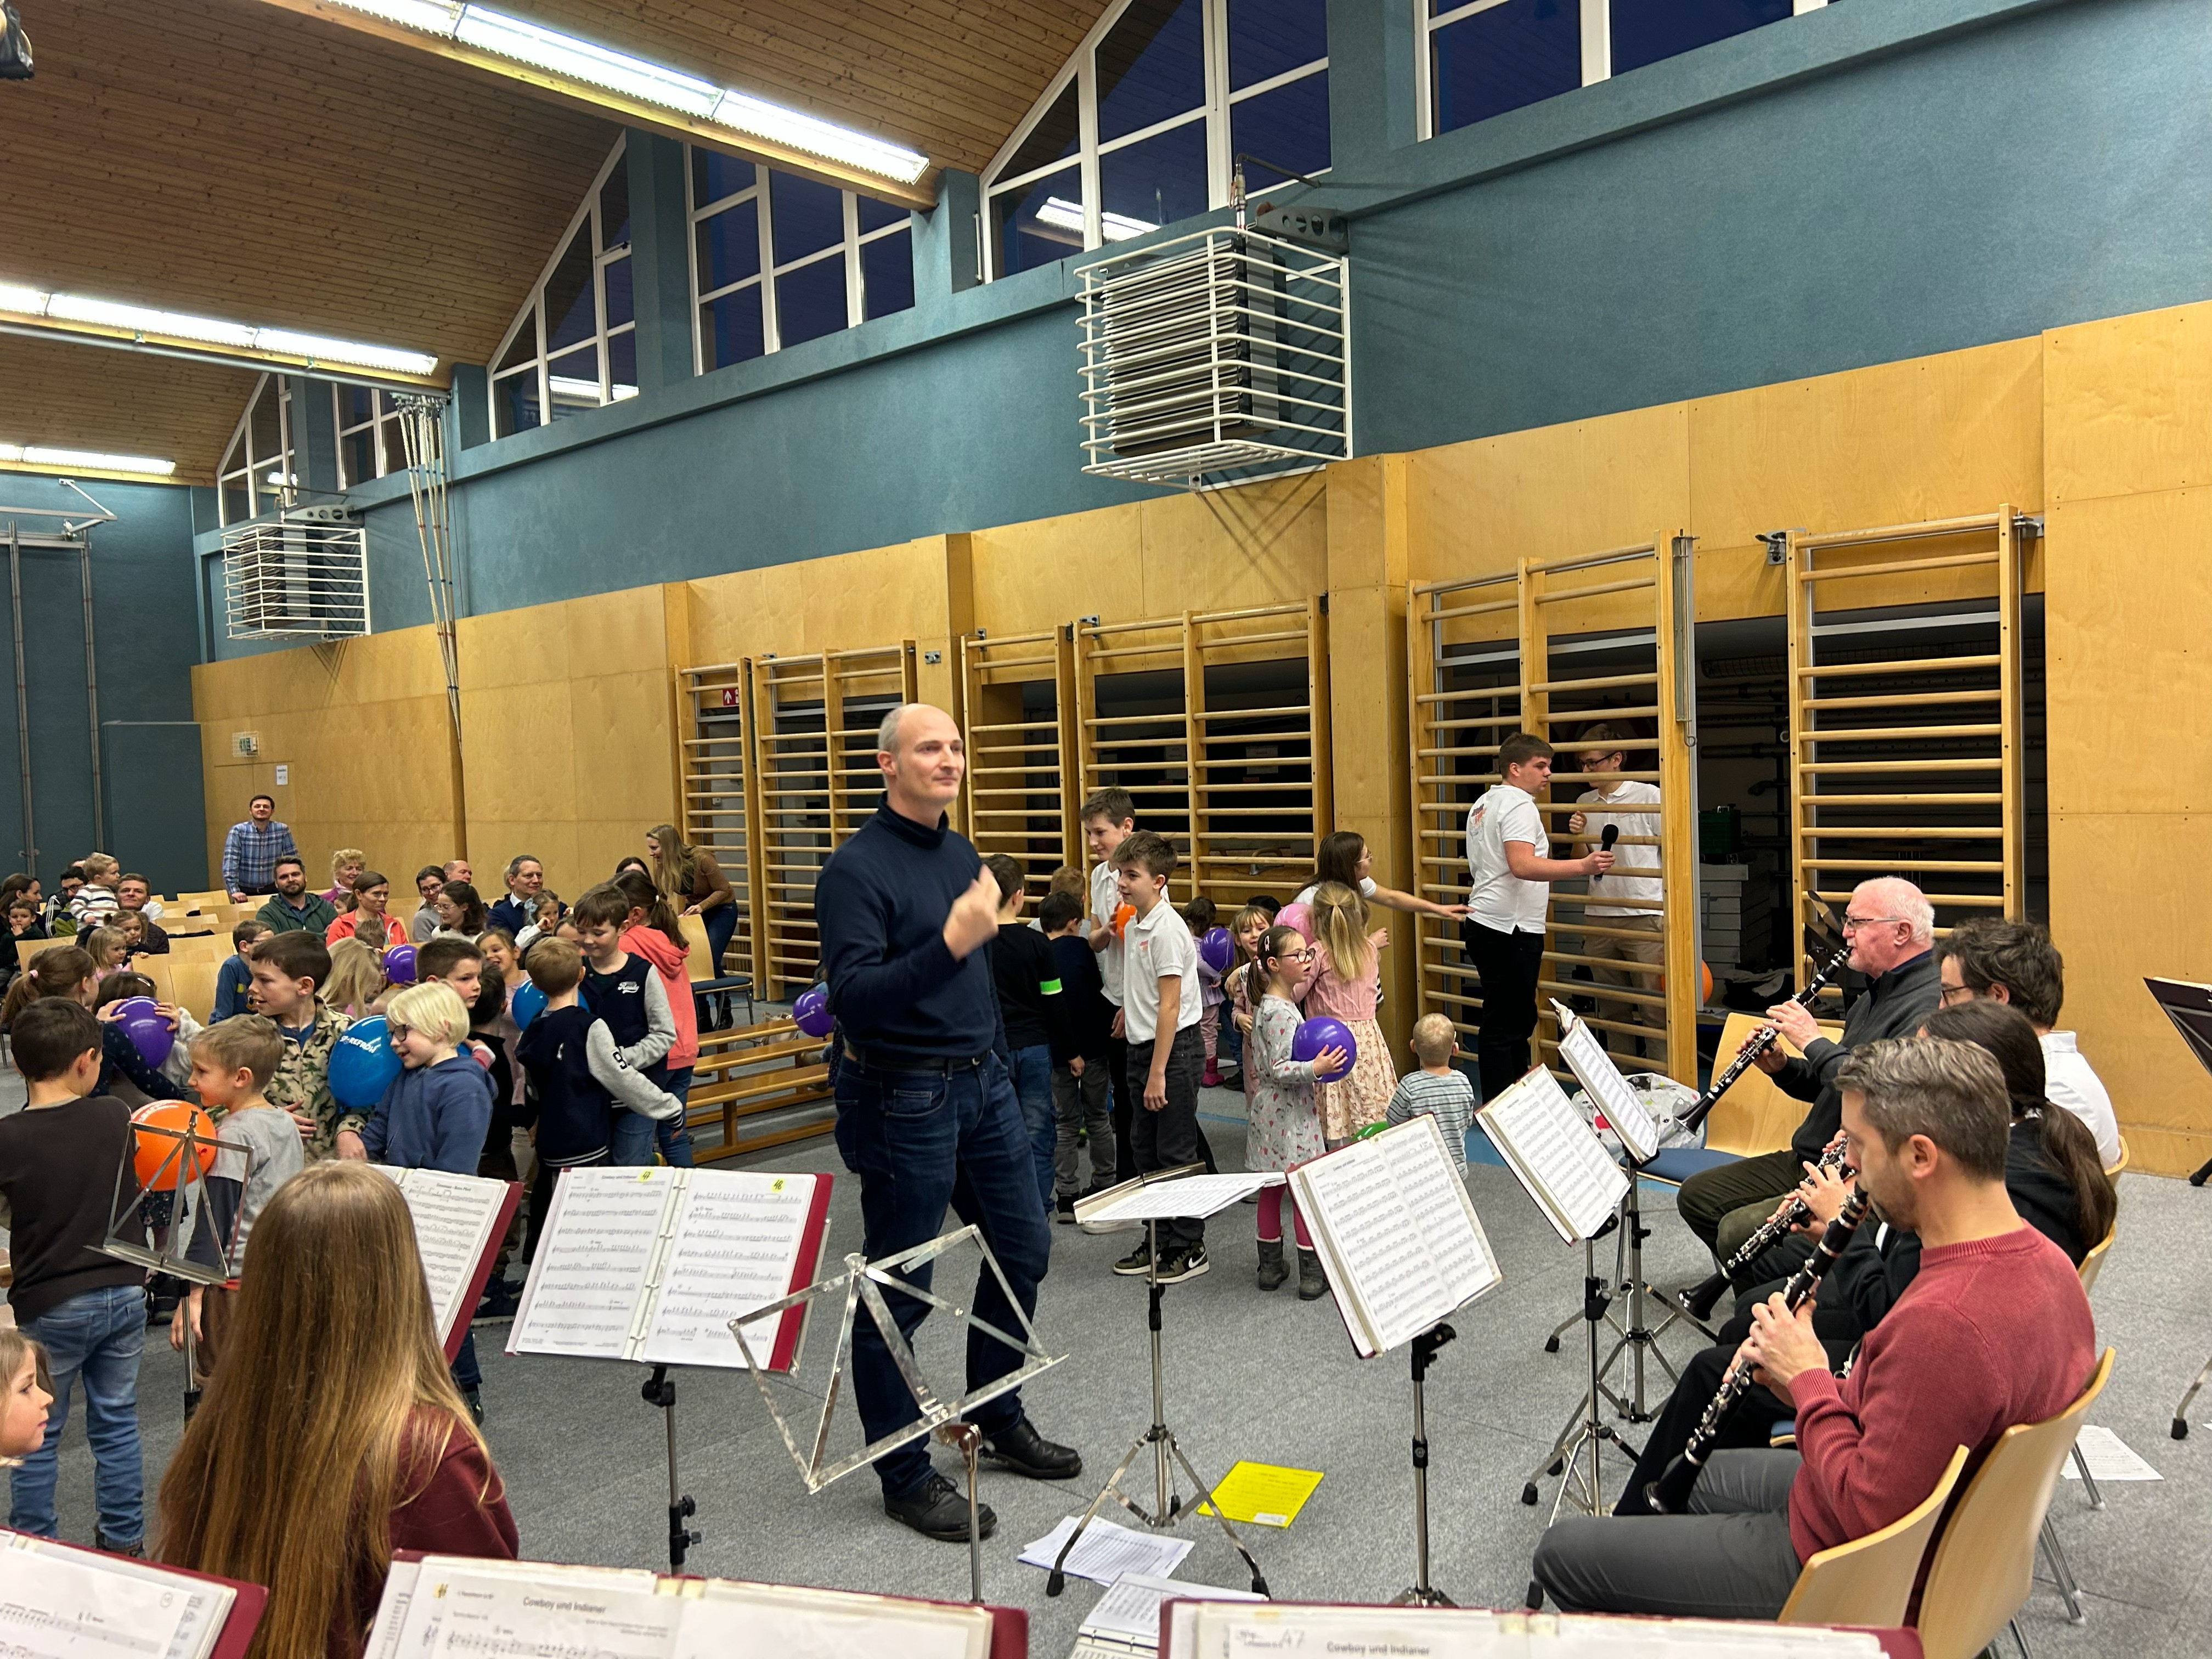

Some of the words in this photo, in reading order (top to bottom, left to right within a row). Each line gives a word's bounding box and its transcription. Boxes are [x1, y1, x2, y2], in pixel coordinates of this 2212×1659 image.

[613, 1051, 627, 1069] 9
[642, 1171, 651, 1180] 47
[774, 1180, 783, 1190] 48
[523, 1596, 555, 1611] Cowboy
[556, 1601, 572, 1611] und
[1327, 1640, 1366, 1656] Cowboy
[1369, 1644, 1387, 1655] und
[1390, 1644, 1430, 1656] Indianer
